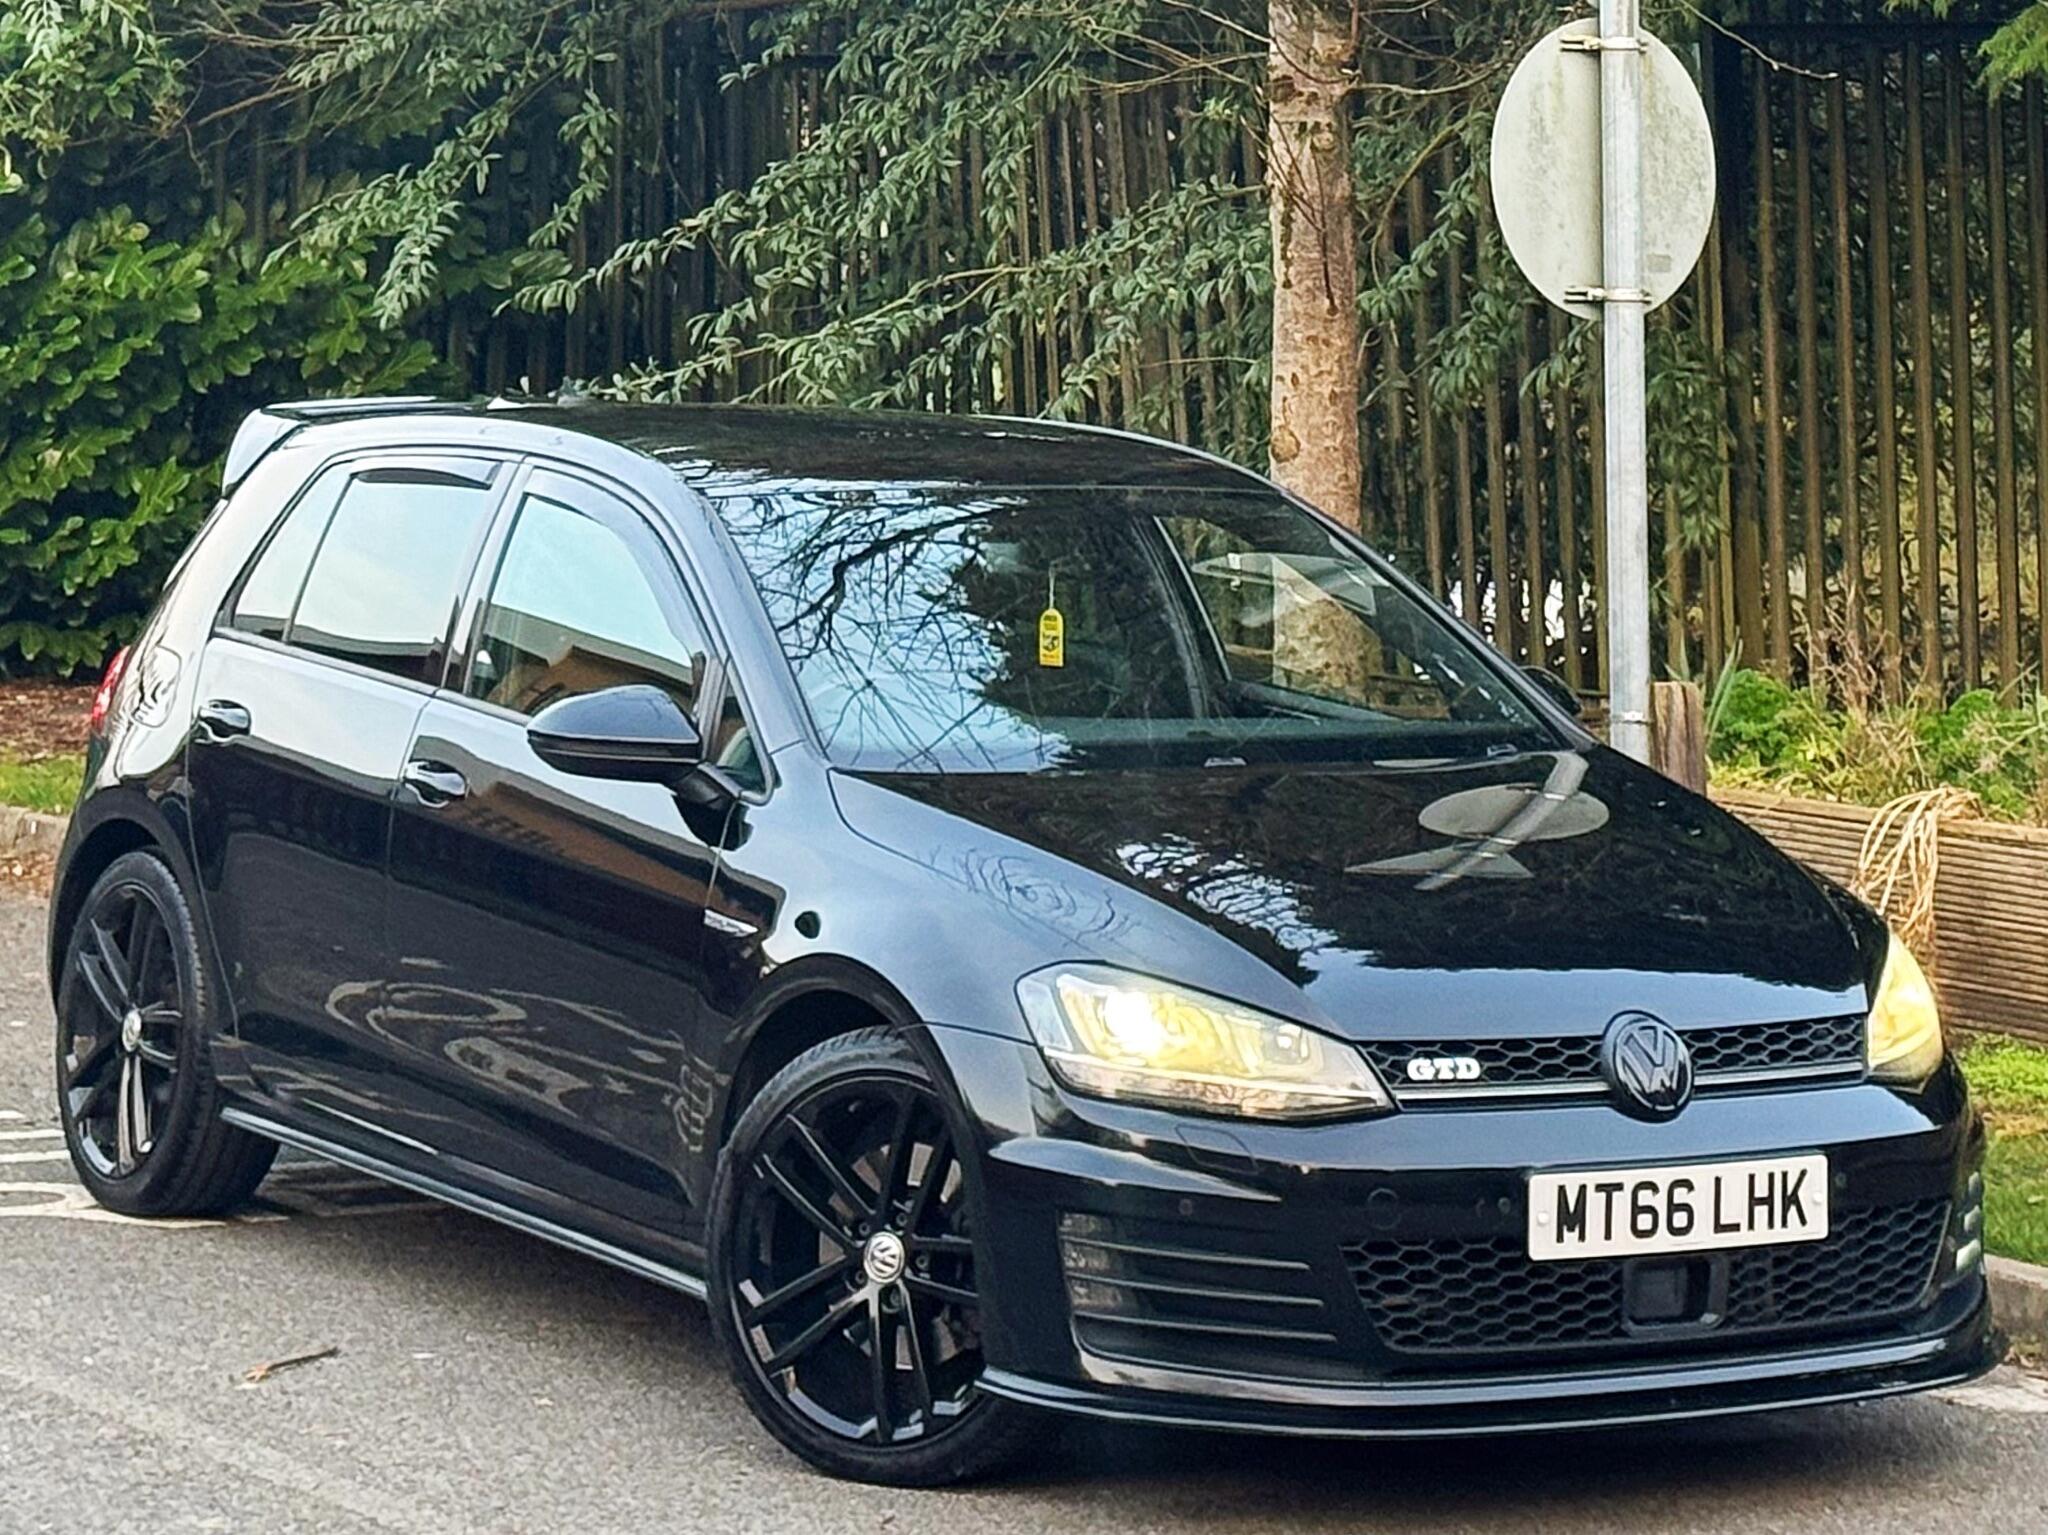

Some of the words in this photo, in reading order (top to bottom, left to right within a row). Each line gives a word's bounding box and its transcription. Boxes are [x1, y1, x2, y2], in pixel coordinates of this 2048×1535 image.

[1406, 1056, 1481, 1082] GTD
[1555, 1178, 1695, 1244] MT66
[1713, 1168, 1808, 1234] LHK
